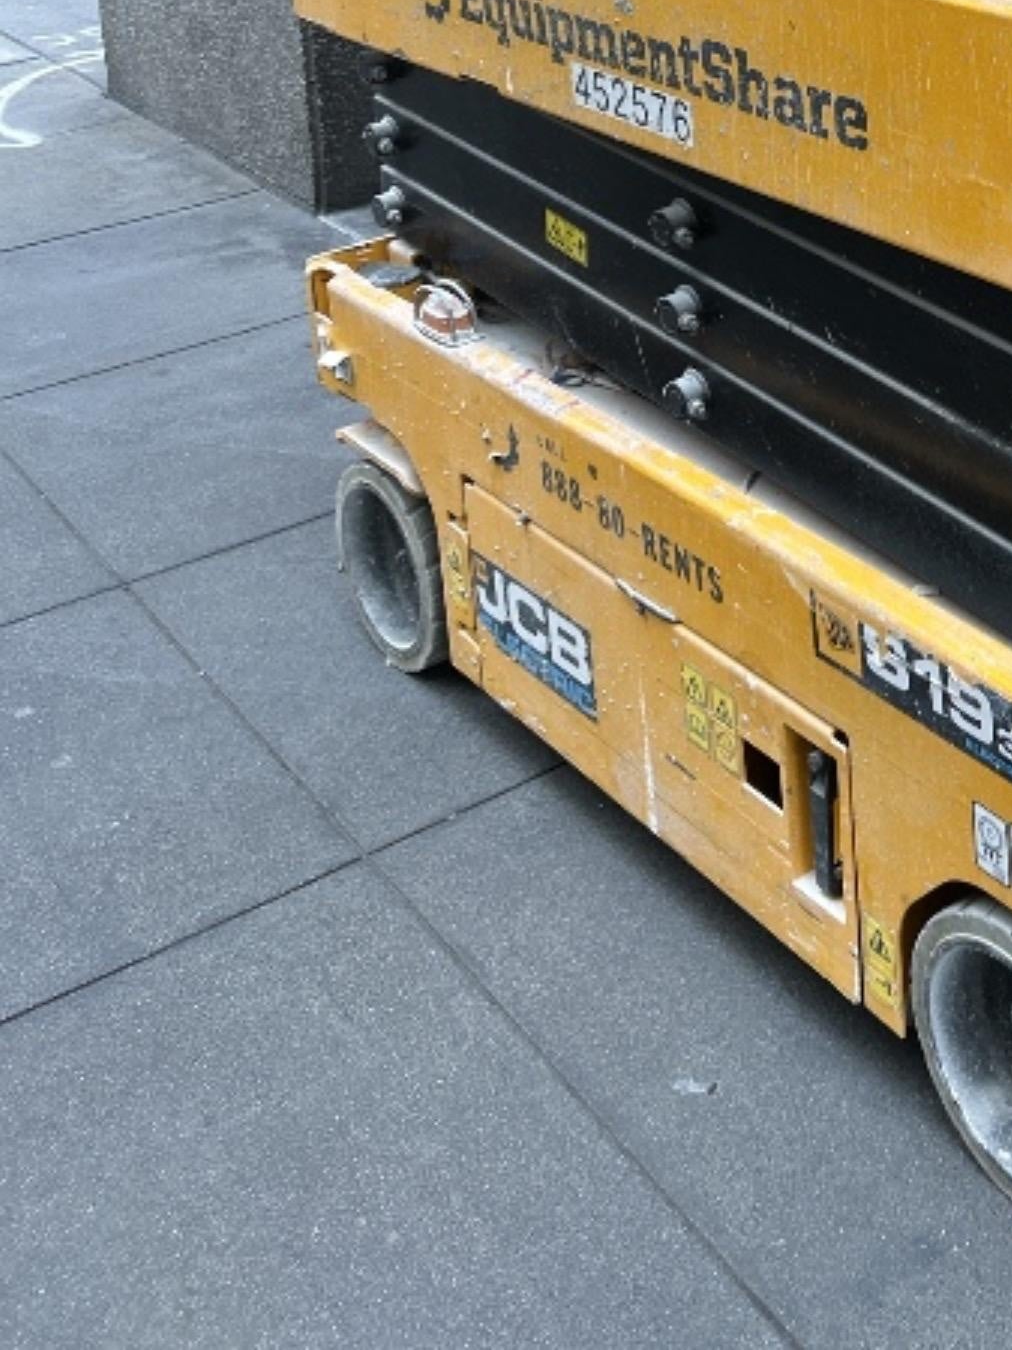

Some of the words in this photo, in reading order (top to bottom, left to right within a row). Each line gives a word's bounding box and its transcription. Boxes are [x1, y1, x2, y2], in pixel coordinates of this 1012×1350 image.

[575, 67, 691, 142] 452576
[541, 460, 724, 603] 888-80-RENTS
[477, 569, 592, 686] JCB
